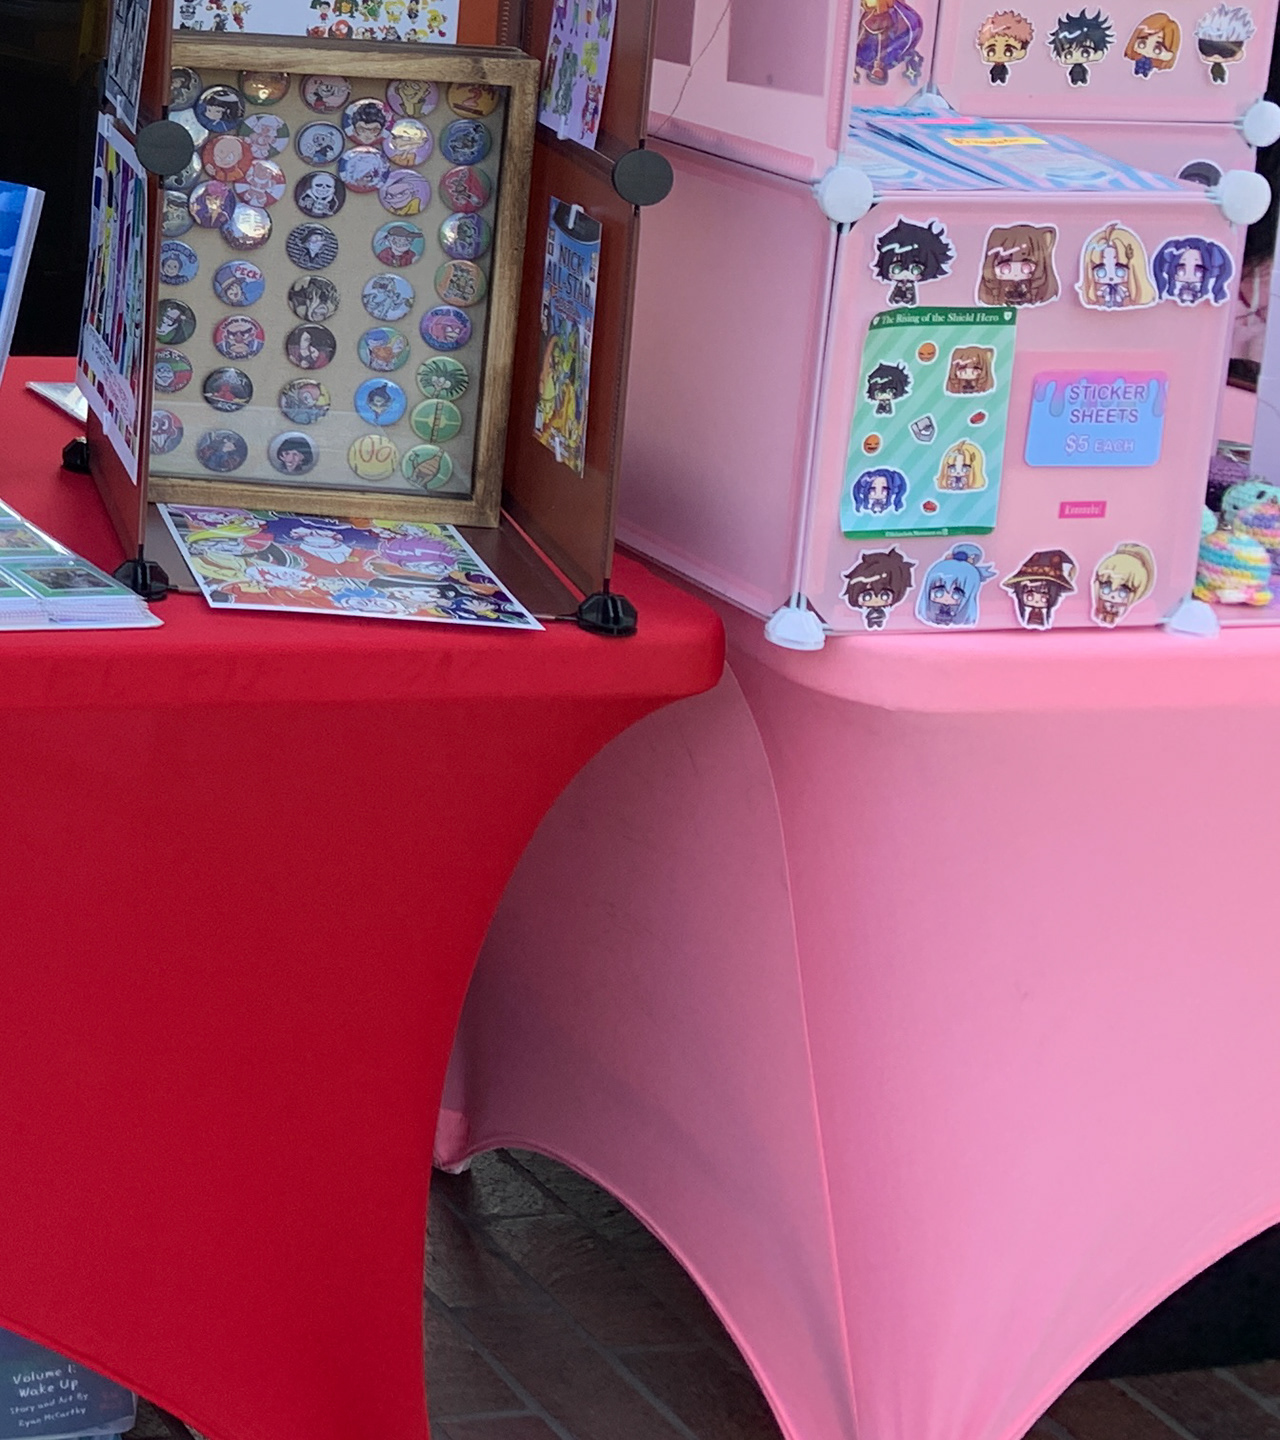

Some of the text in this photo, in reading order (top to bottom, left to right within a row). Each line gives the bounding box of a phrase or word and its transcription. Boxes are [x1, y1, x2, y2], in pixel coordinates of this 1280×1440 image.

[559, 243, 585, 275] NICK
[235, 265, 262, 280] PECK!
[882, 311, 999, 324] The Rising of the Shield Hero
[1070, 386, 1145, 400] STICKER
[1070, 409, 1139, 423] SHEETS
[1065, 434, 1134, 453] $5 EACH
[13, 1368, 62, 1384] Volume
[19, 1379, 78, 1398] Wake Up
[10, 1404, 35, 1415] Story
[38, 1399, 55, 1409] and
[58, 1395, 73, 1404] Art
[19, 1407, 86, 1428] Ryan McCarthy
